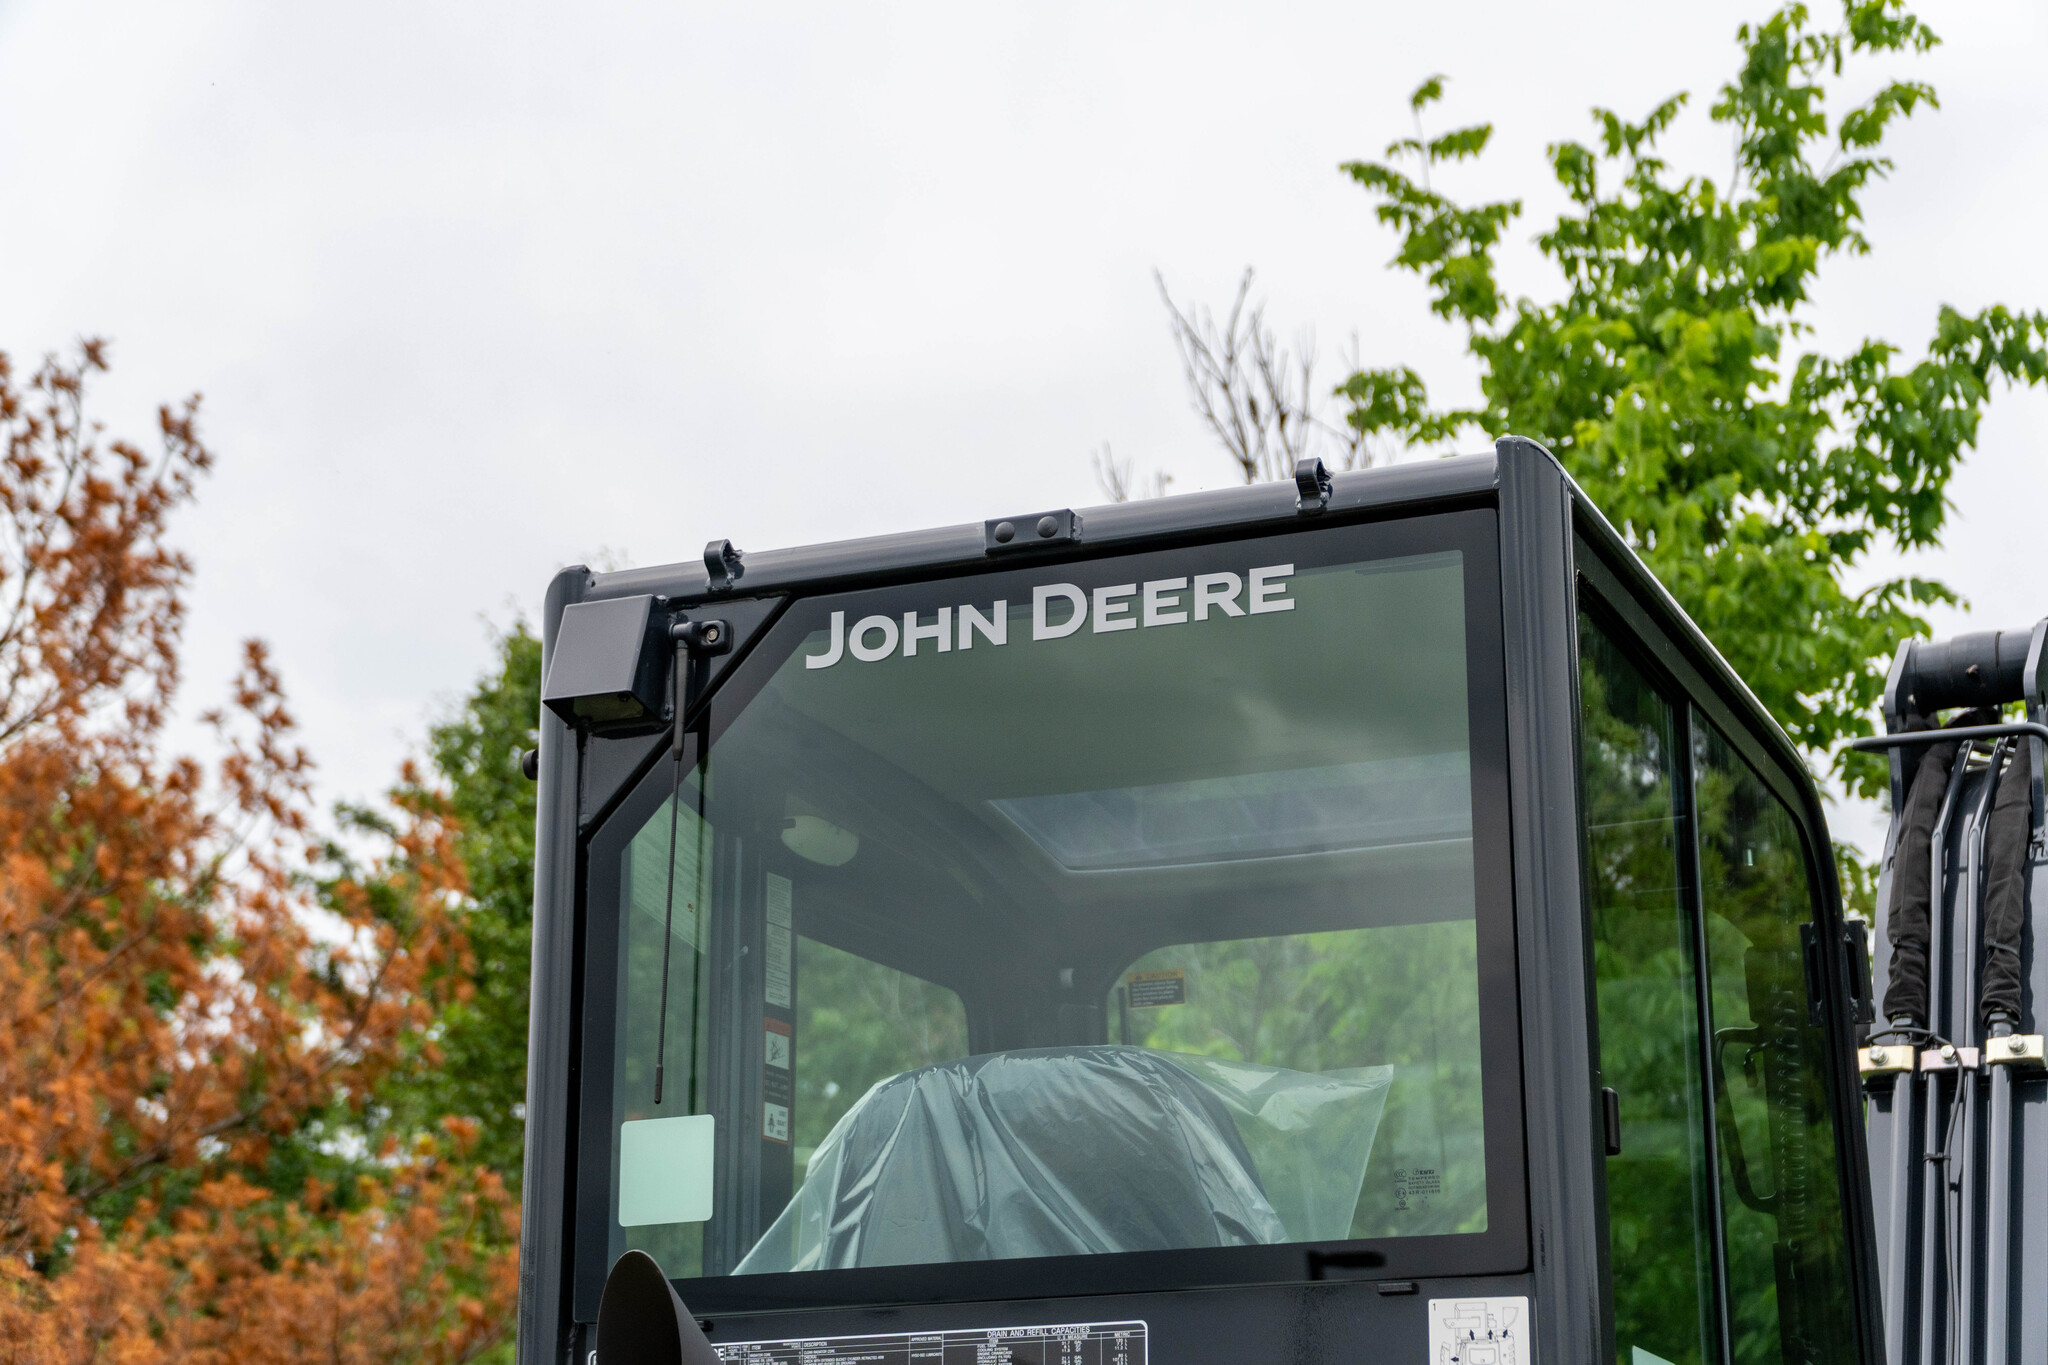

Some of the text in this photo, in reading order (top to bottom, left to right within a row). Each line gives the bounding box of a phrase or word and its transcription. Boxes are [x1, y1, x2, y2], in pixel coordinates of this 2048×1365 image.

[806, 564, 1296, 669] JOHN DEERE
[1051, 1326, 1090, 1334] CAPACITIES
